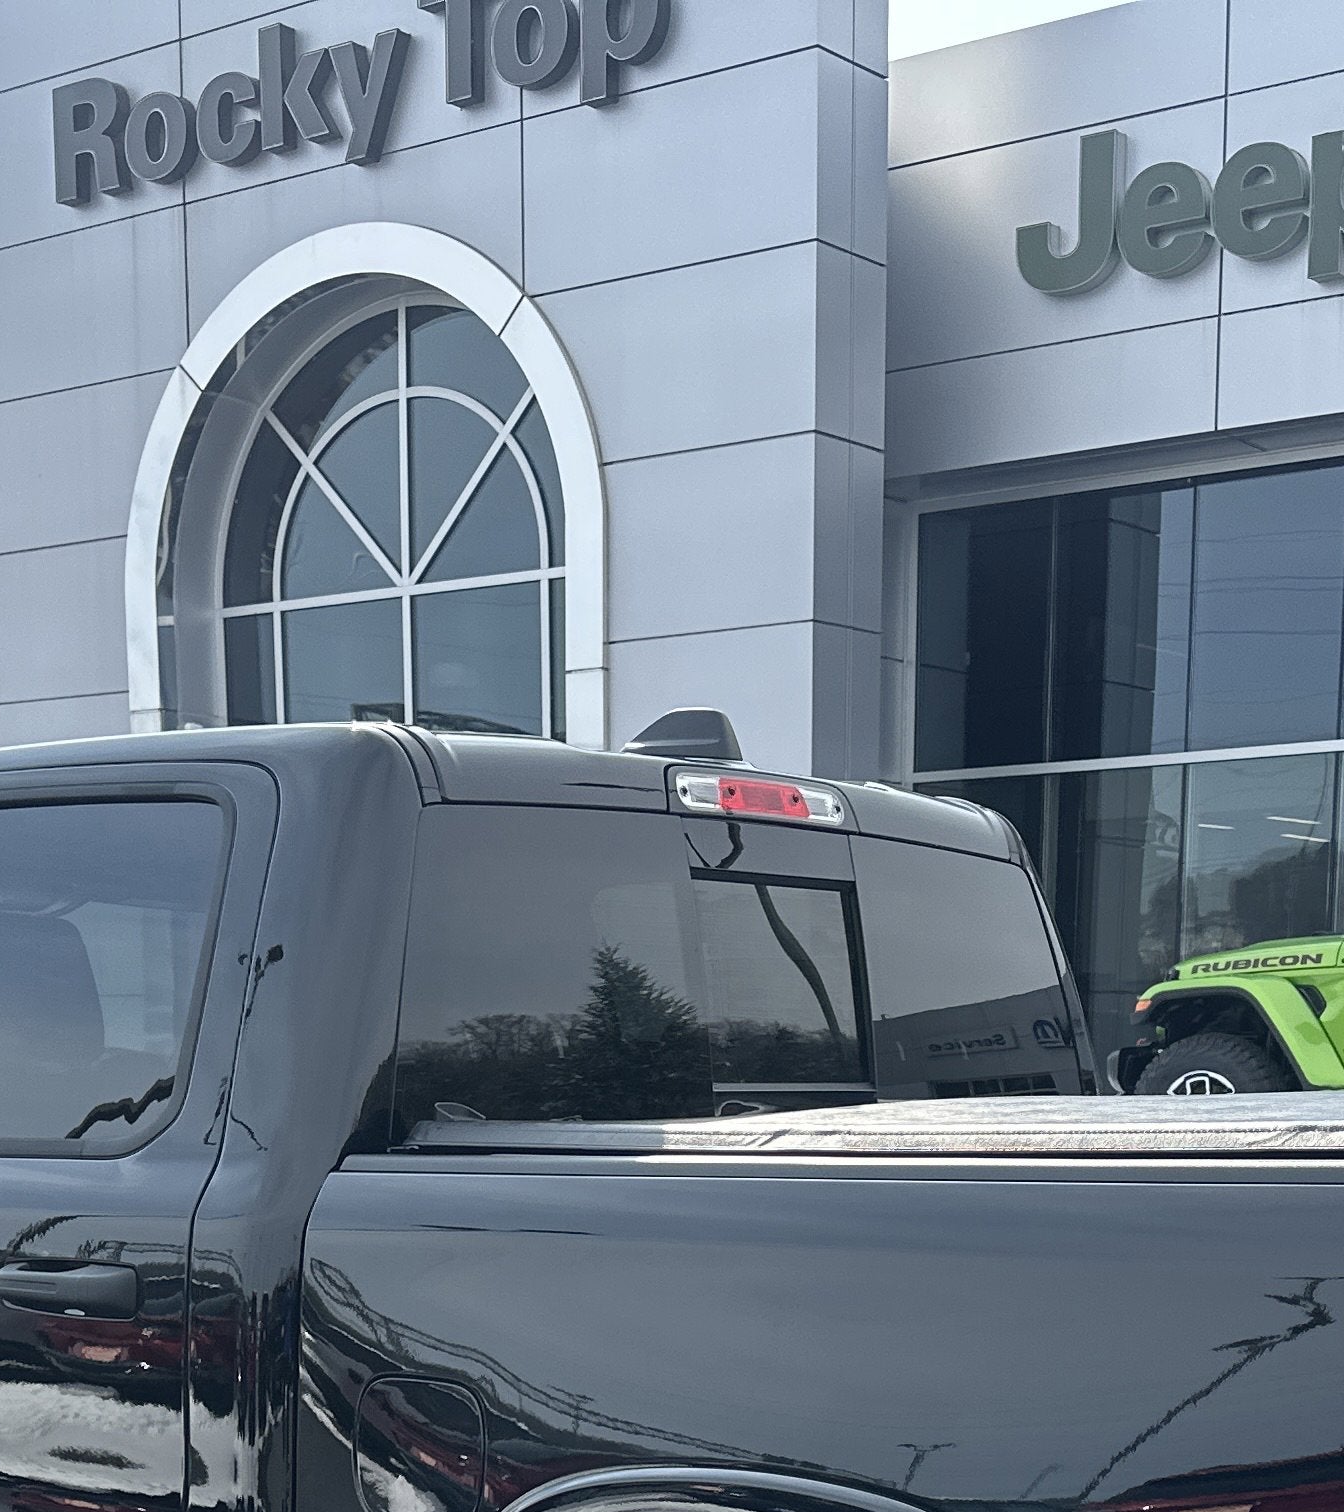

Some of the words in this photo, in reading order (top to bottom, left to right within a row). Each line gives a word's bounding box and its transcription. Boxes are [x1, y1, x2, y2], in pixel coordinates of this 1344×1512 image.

[53, 22, 410, 206] Rocky
[417, 0, 670, 108] Top
[1191, 953, 1323, 974] RUBICON
